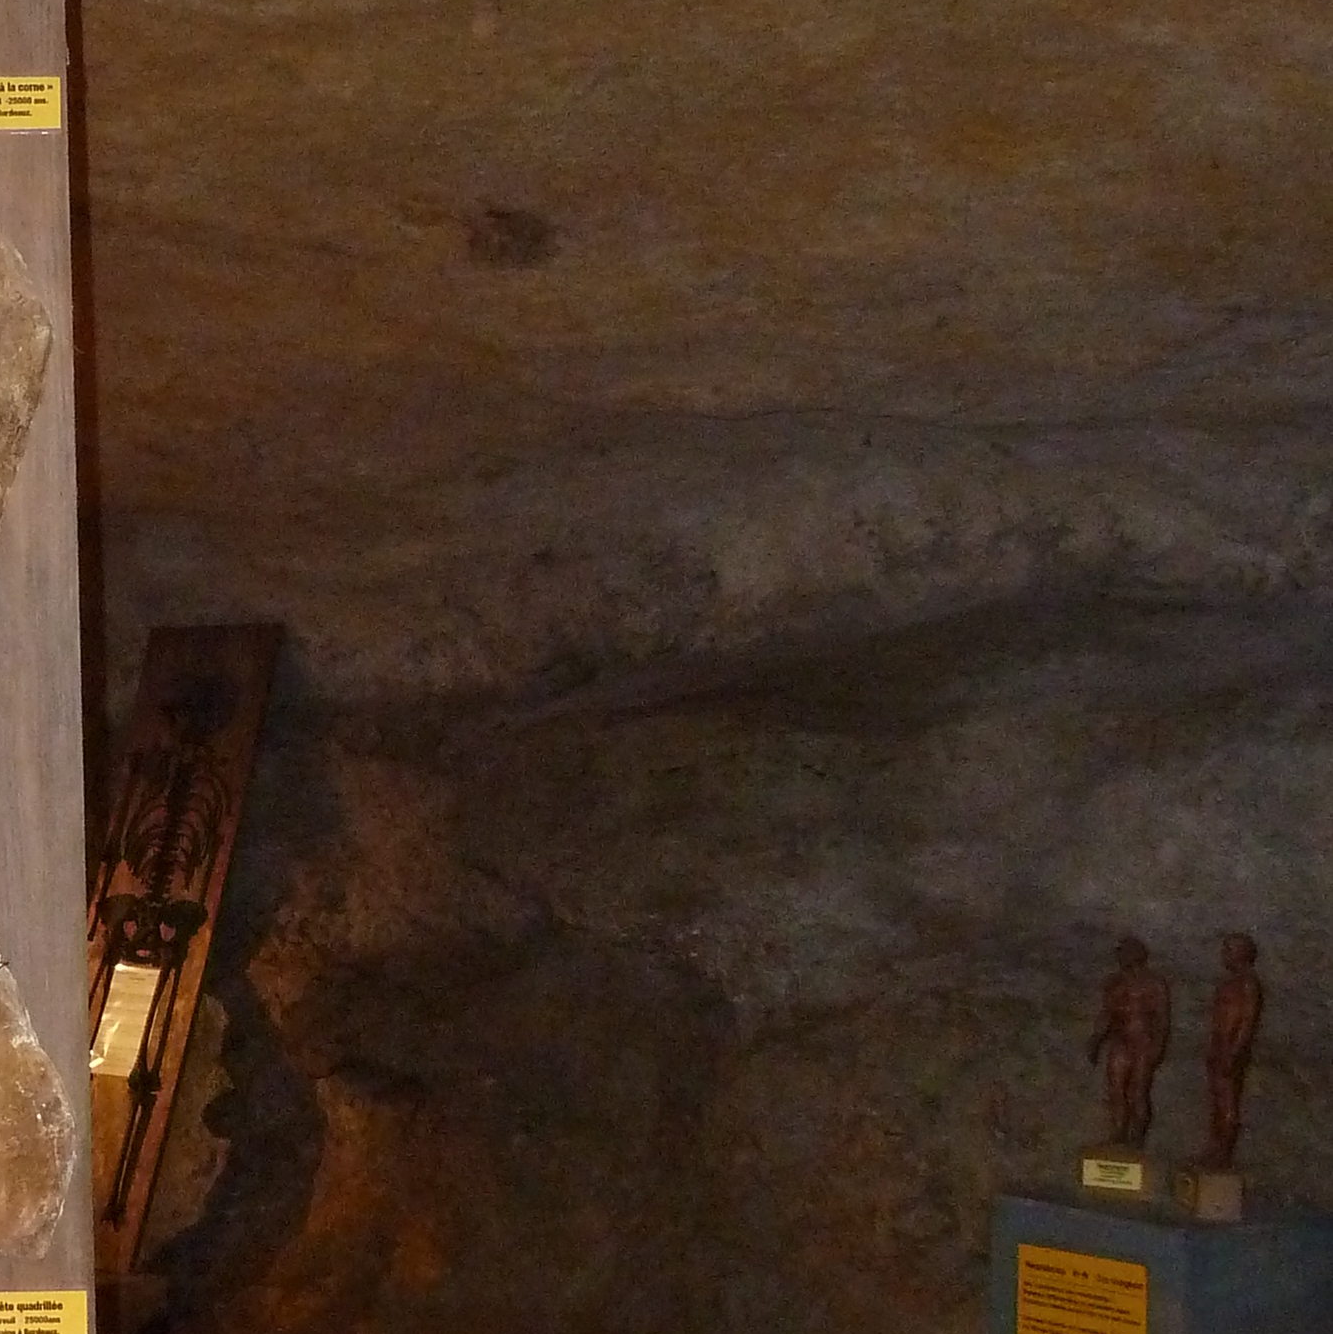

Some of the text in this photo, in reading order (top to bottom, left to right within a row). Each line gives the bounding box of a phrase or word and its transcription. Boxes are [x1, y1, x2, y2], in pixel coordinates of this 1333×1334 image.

[0, 82, 5, 92] à
[7, 82, 16, 92] la
[17, 1301, 63, 1313] quadrillée
